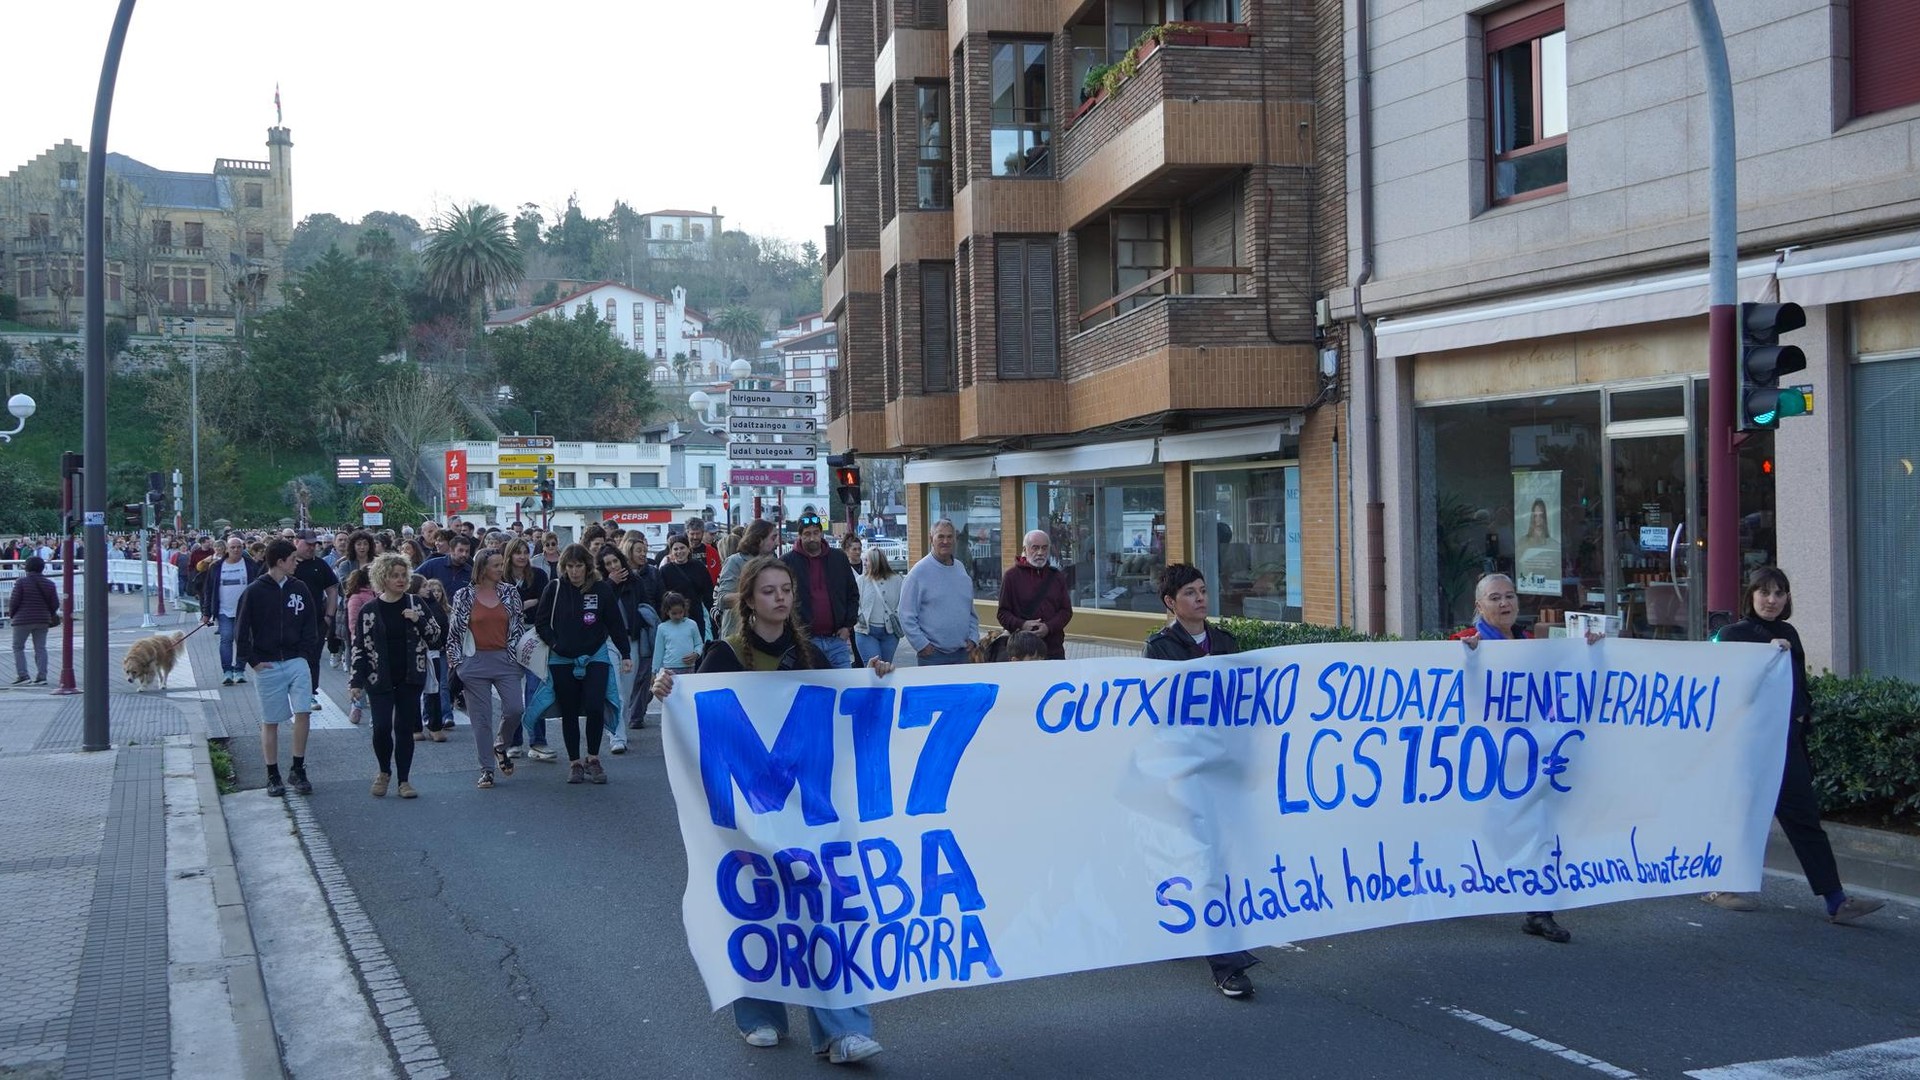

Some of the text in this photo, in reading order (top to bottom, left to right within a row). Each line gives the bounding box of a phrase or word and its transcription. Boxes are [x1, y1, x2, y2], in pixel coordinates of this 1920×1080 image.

[732, 394, 771, 403] hirigunea
[732, 421, 787, 431] udaltzaingoa
[732, 447, 794, 456] udal bulegoak
[732, 473, 770, 481] museoak
[621, 513, 649, 521] CEPSA
[1035, 663, 1300, 733] GUTXIENEKO
[1309, 661, 1466, 725] SOLDATA
[1598, 670, 1721, 732] ERABAKI
[693, 682, 1000, 829] M17
[1277, 726, 1388, 815] LGS
[716, 829, 986, 925] GREBA
[1155, 825, 1723, 934] Soldatak hobetu, aberastasuna banatzeko
[727, 914, 1004, 994] OROKORRA
